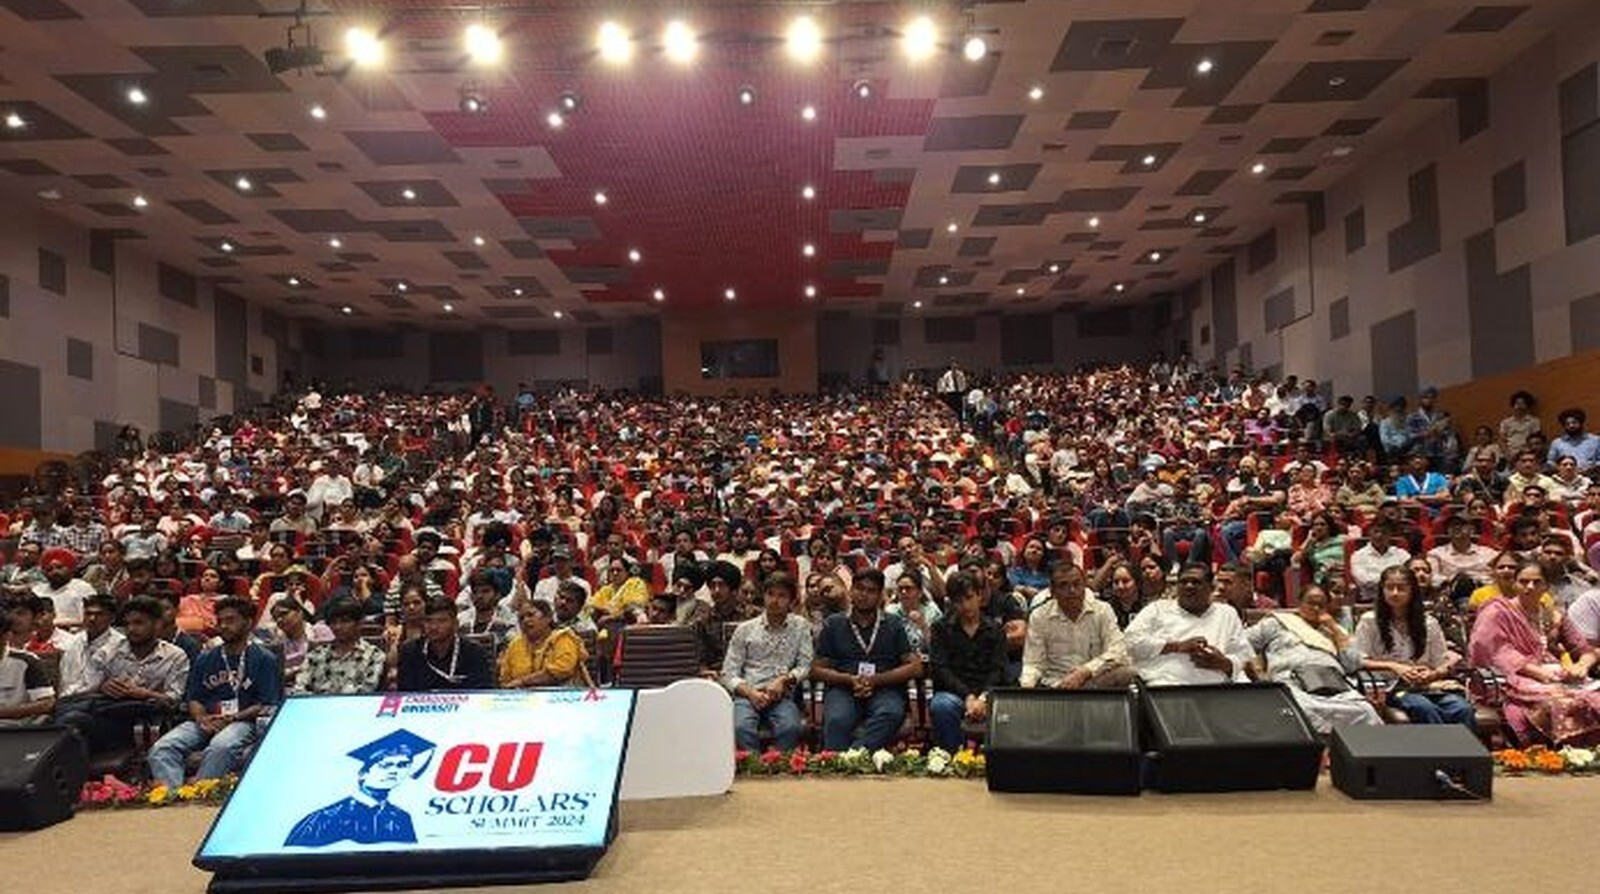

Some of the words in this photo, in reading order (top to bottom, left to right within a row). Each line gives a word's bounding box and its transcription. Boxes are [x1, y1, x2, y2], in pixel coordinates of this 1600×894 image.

[434, 742, 544, 793] CU
[471, 815, 542, 829] SUMMIT
[546, 814, 586, 827] 2024
